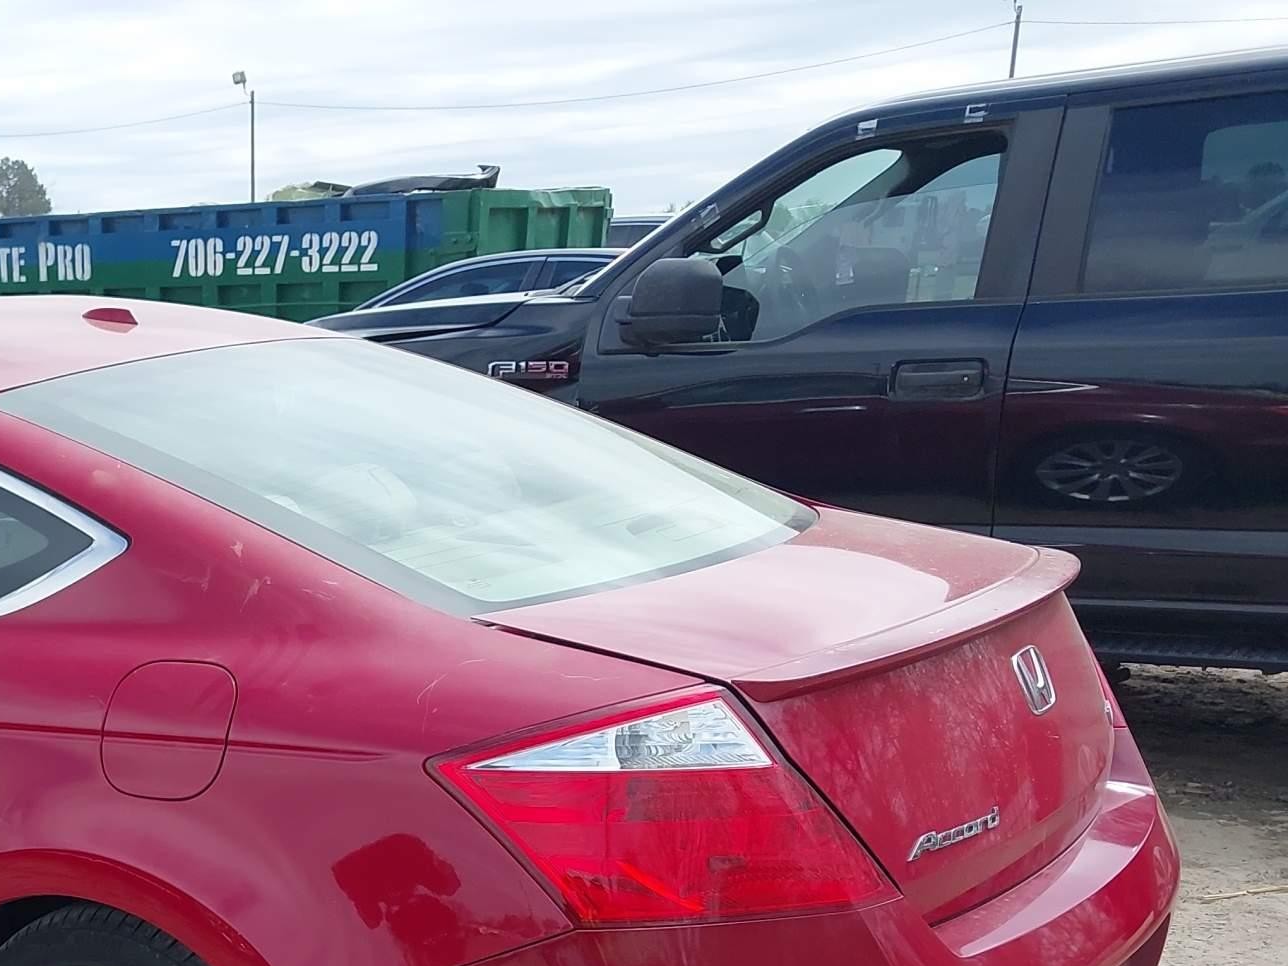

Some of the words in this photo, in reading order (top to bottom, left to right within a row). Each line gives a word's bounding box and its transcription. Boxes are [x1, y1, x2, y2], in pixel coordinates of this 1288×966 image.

[38, 241, 93, 283] PRO
[170, 230, 379, 278] 706-227-3222
[906, 805, 1000, 862] Accord
